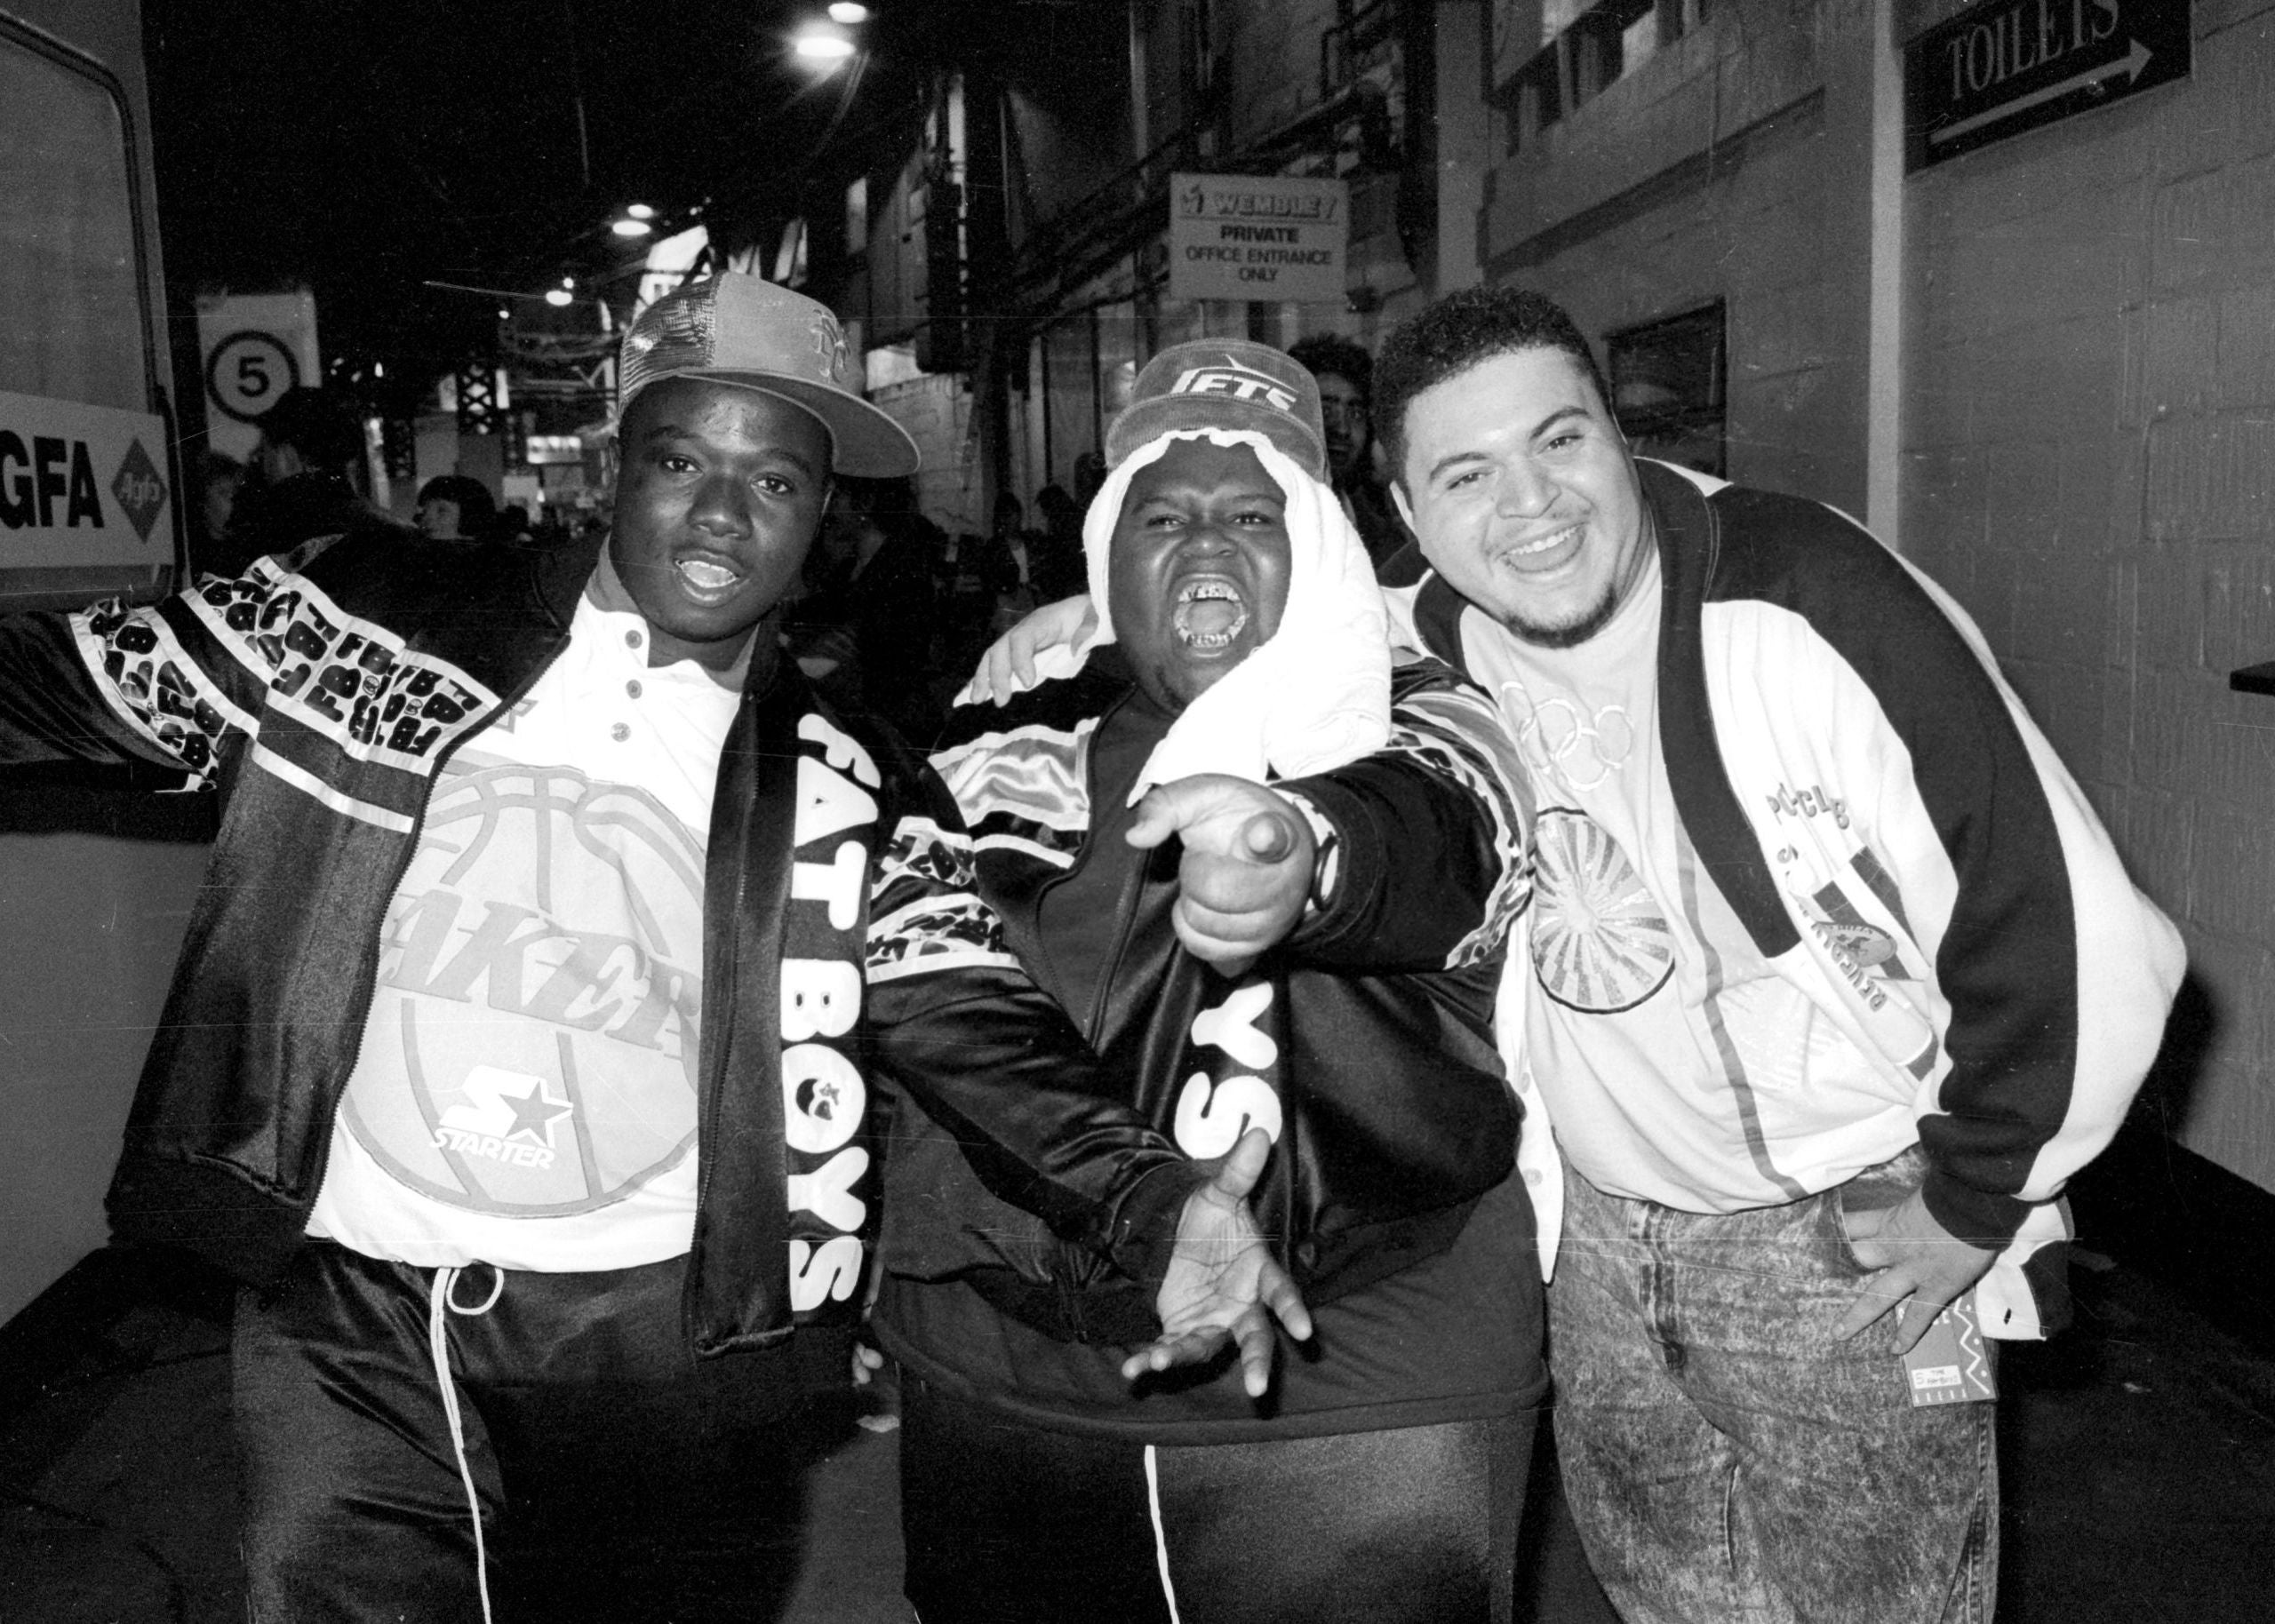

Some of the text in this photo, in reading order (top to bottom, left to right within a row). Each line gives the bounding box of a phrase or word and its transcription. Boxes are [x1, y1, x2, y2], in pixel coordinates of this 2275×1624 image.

[1214, 190, 1338, 219] WEMBLEY
[1219, 225, 1300, 244] PRIVATE
[1185, 245, 1333, 266] OFFICE ENTRANCE
[1238, 267, 1279, 282] ONLY
[236, 355, 270, 398] 5
[0, 429, 105, 530] GFA
[780, 712, 882, 1312] FAT BOYS
[428, 1126, 556, 1171] STARTER
